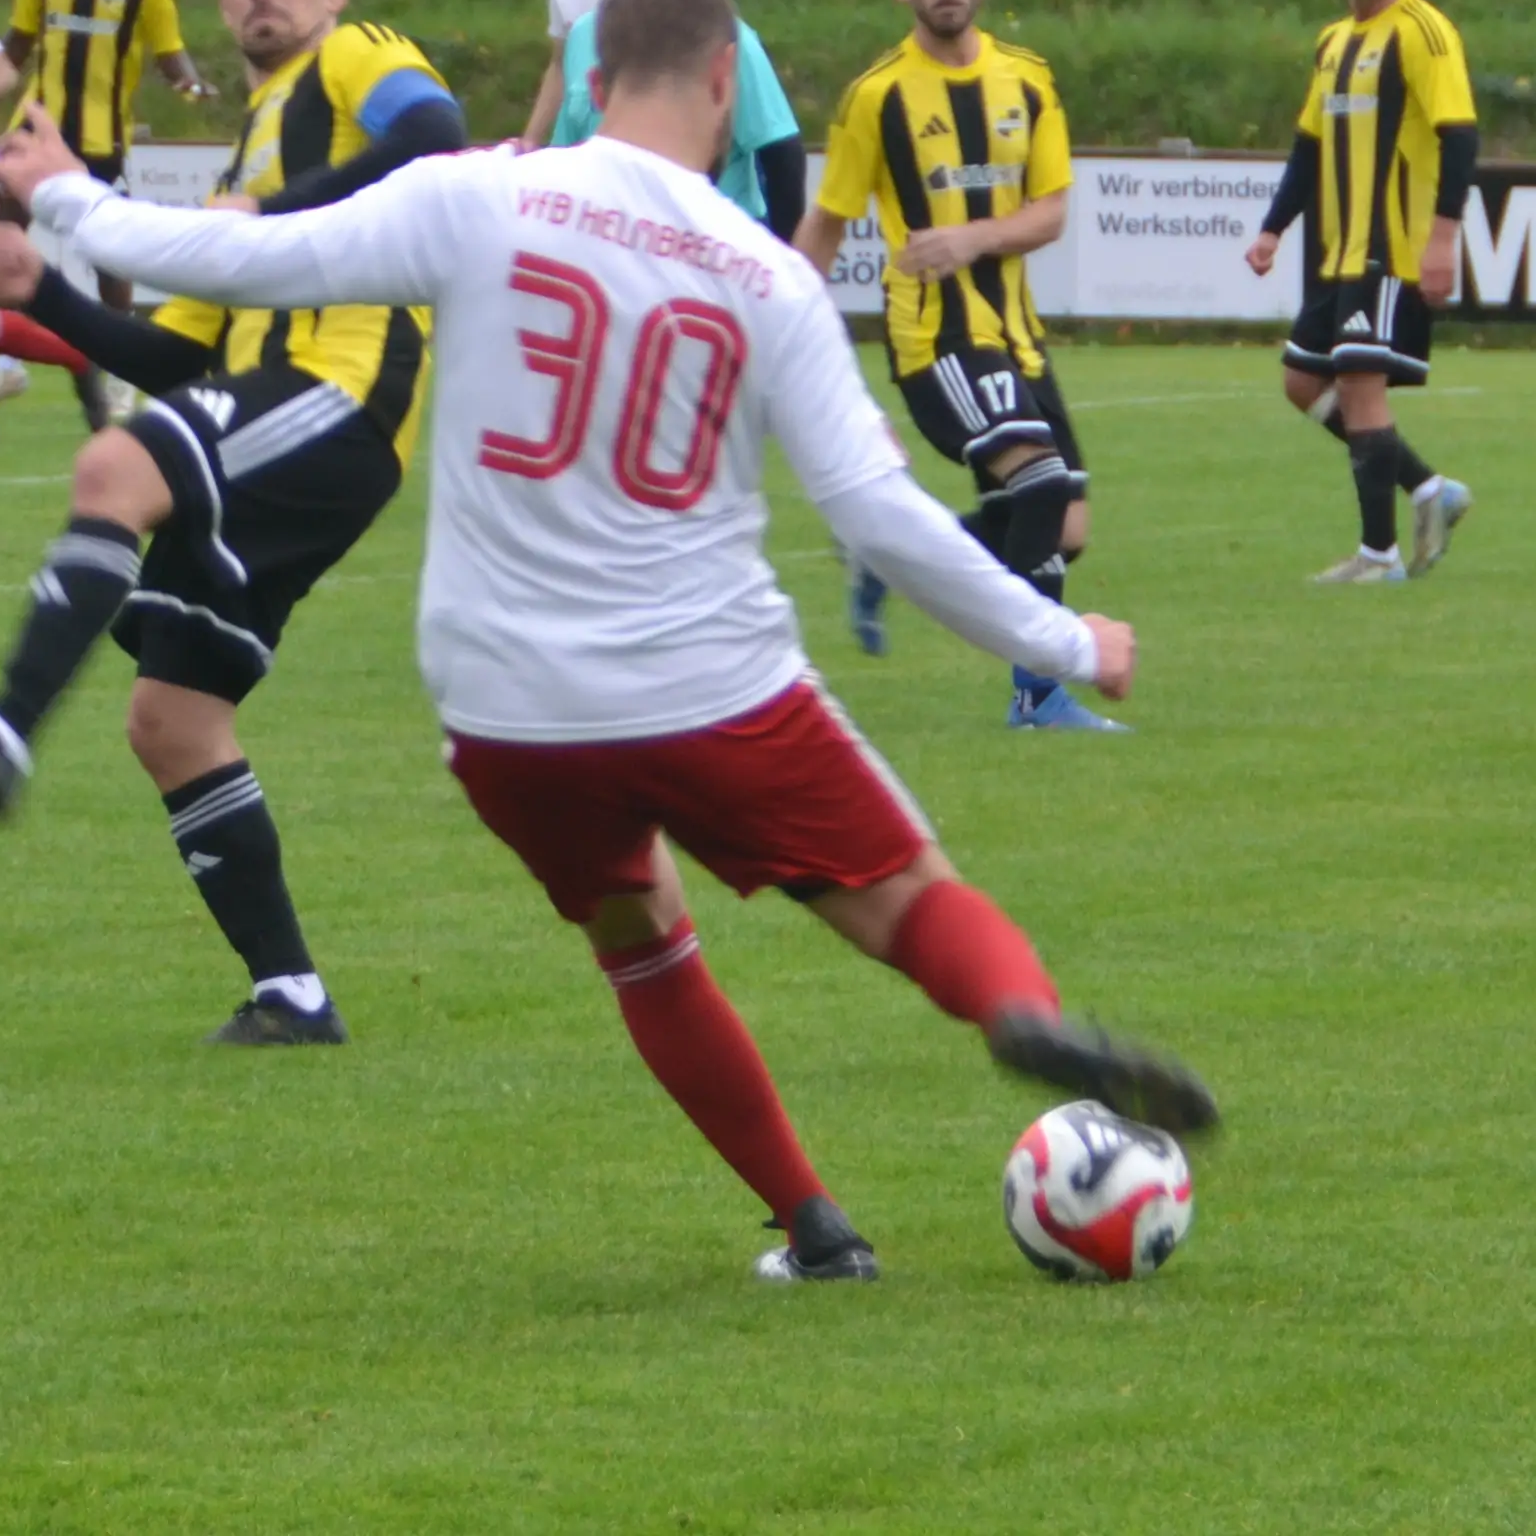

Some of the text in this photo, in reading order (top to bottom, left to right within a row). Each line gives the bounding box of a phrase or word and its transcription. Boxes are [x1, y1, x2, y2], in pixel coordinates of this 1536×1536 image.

[1098, 174, 1143, 196] Wir
[1098, 213, 1245, 237] Werkstoffe
[478, 249, 748, 512] 30
[977, 370, 1016, 414] 17
